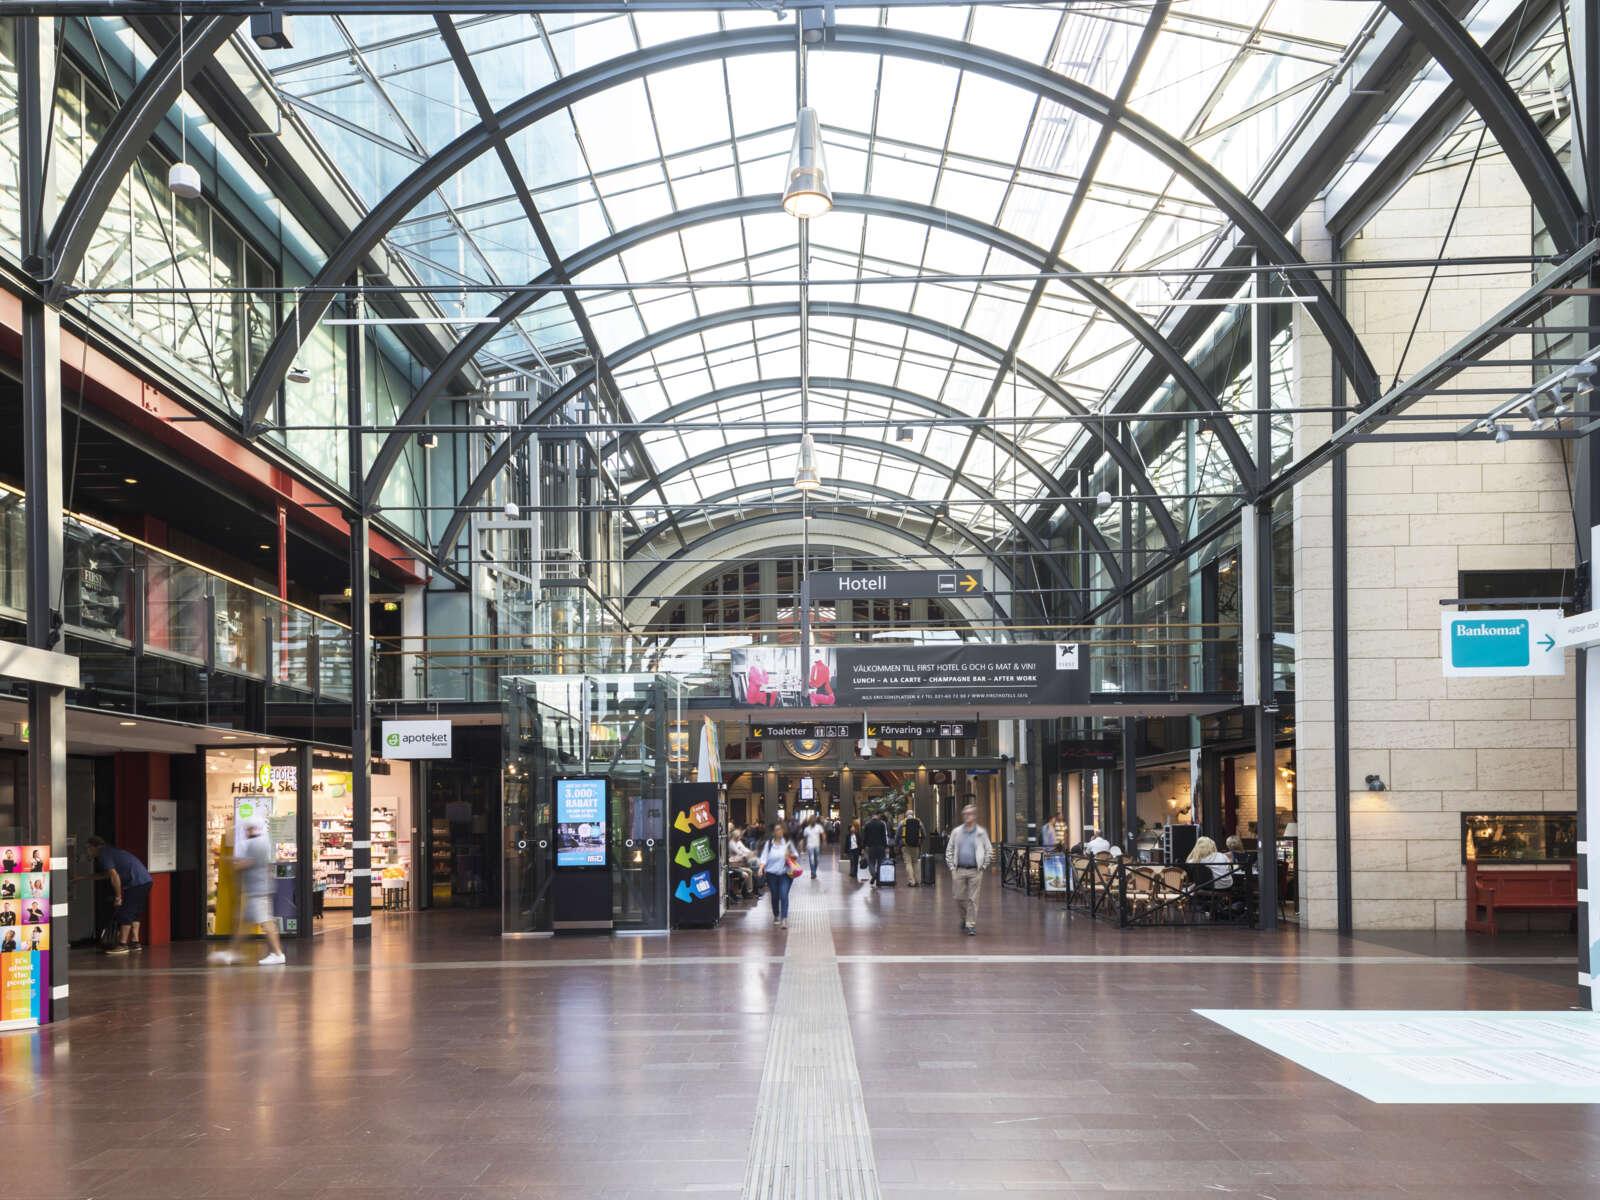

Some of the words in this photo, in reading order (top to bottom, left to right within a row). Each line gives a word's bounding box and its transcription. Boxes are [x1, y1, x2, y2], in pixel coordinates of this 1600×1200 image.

[839, 575, 888, 591] Hotell
[853, 663, 901, 673] VÄLKOMMEN
[903, 664, 915, 672] TILL
[937, 663, 959, 671] HOTEL
[961, 663, 968, 671] G
[969, 663, 986, 671] OCH
[988, 663, 994, 671] G
[767, 727, 807, 736] Toaletter
[880, 725, 922, 736] Förvaring
[402, 732, 448, 744] apoteket
[231, 782, 263, 794] Hälsa
[565, 799, 598, 808] RABATT
[8, 964, 34, 972] about
[7, 978, 36, 988] people
